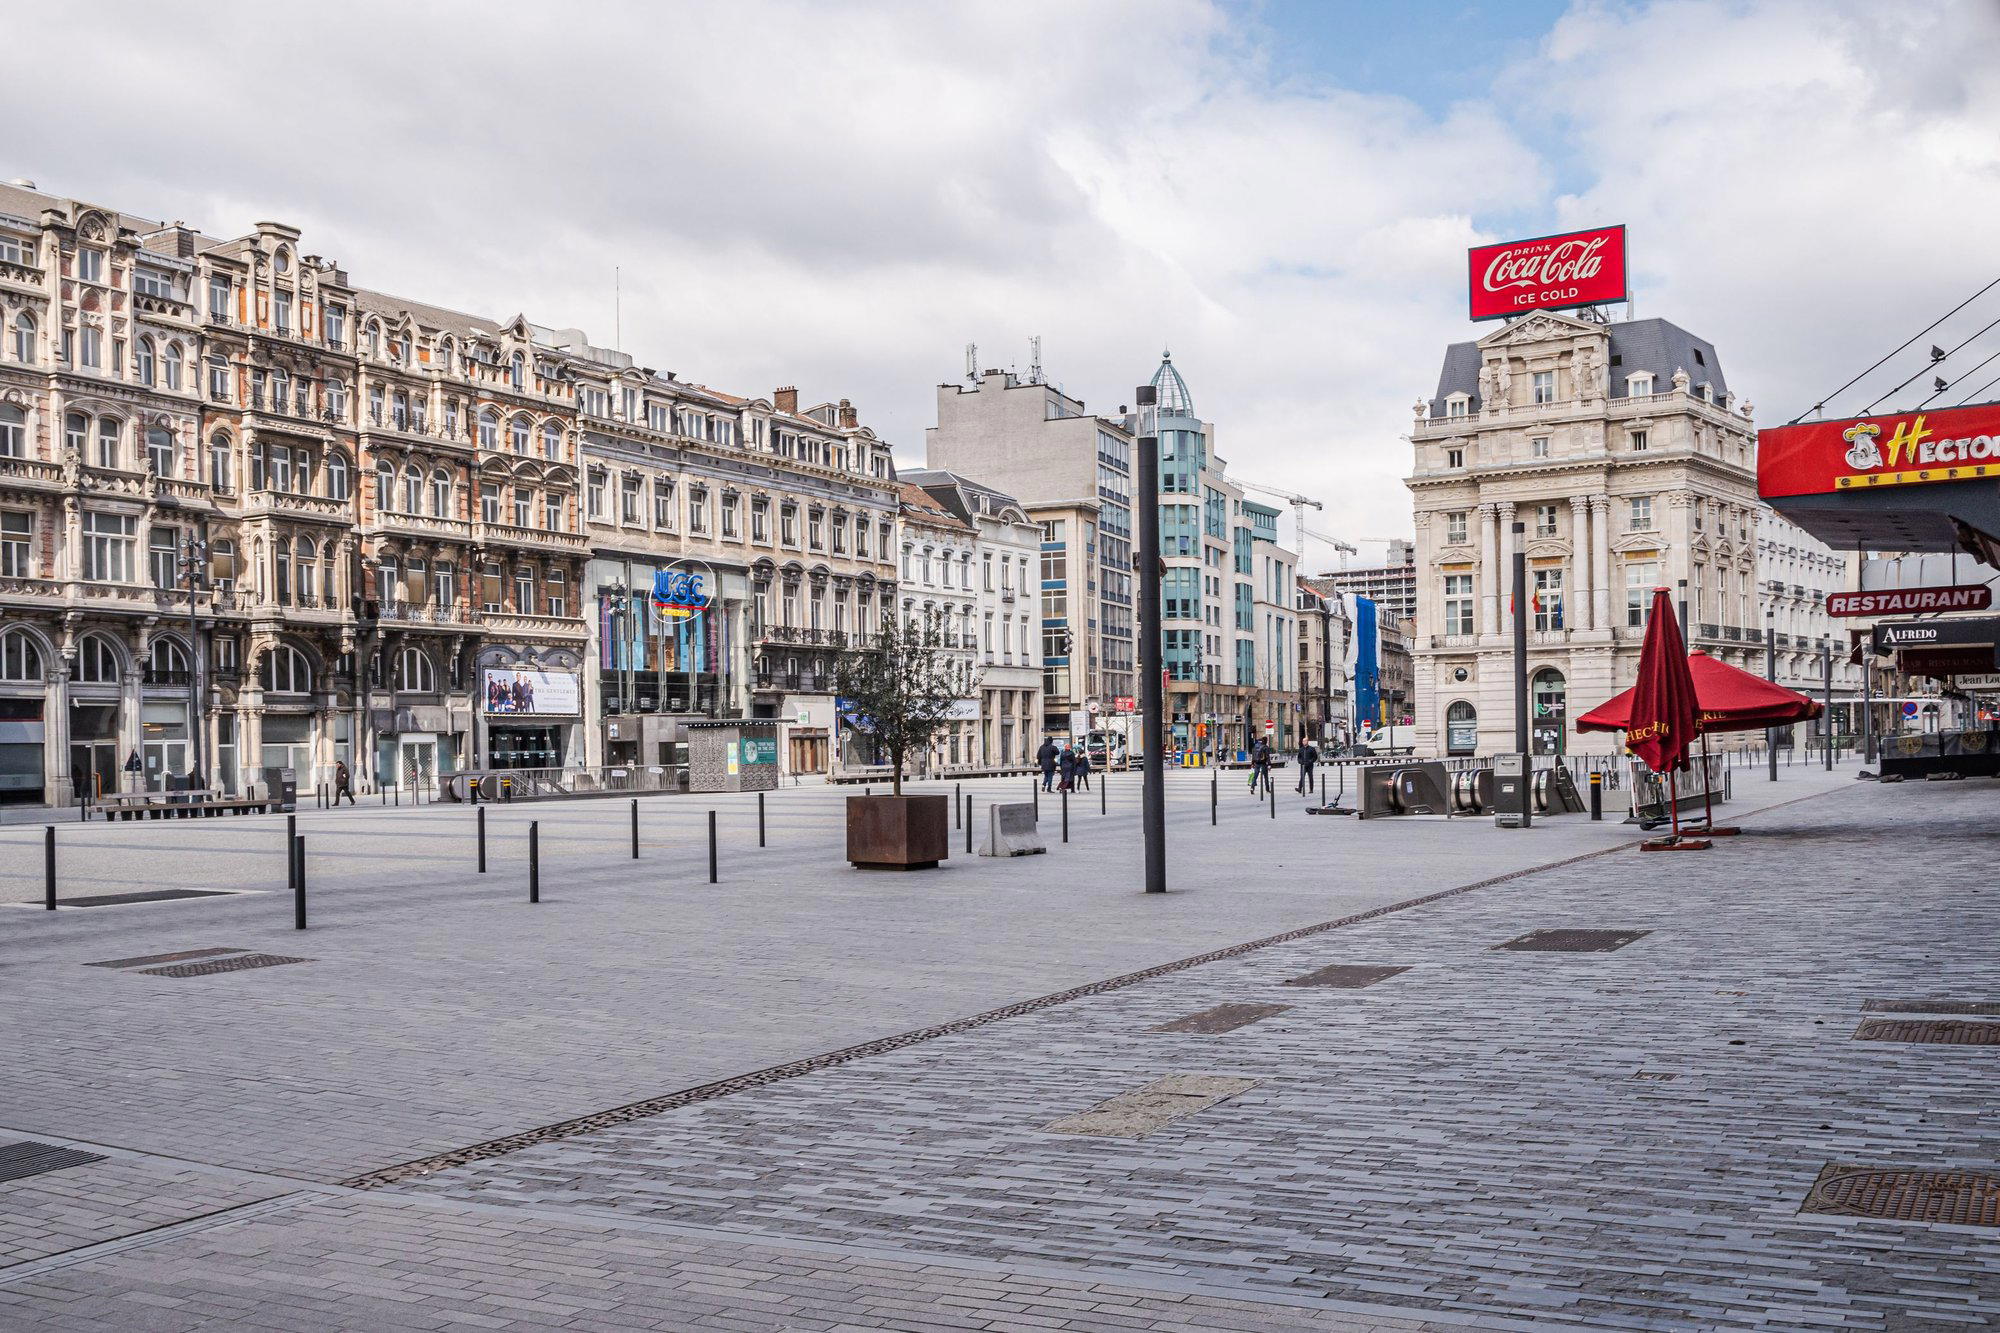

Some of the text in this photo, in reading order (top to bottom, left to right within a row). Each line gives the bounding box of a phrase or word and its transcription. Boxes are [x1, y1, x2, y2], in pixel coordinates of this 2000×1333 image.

[1513, 244, 1552, 256] DRINK
[1483, 235, 1610, 292] Coca-Cola
[1513, 287, 1579, 305] ICE COLD
[653, 570, 706, 606] UGC
[1831, 589, 1986, 613] RESTAURANT
[1882, 627, 1938, 643] ALFREDO
[1959, 675, 1982, 685] Jean
[1626, 726, 1654, 742] HEC
